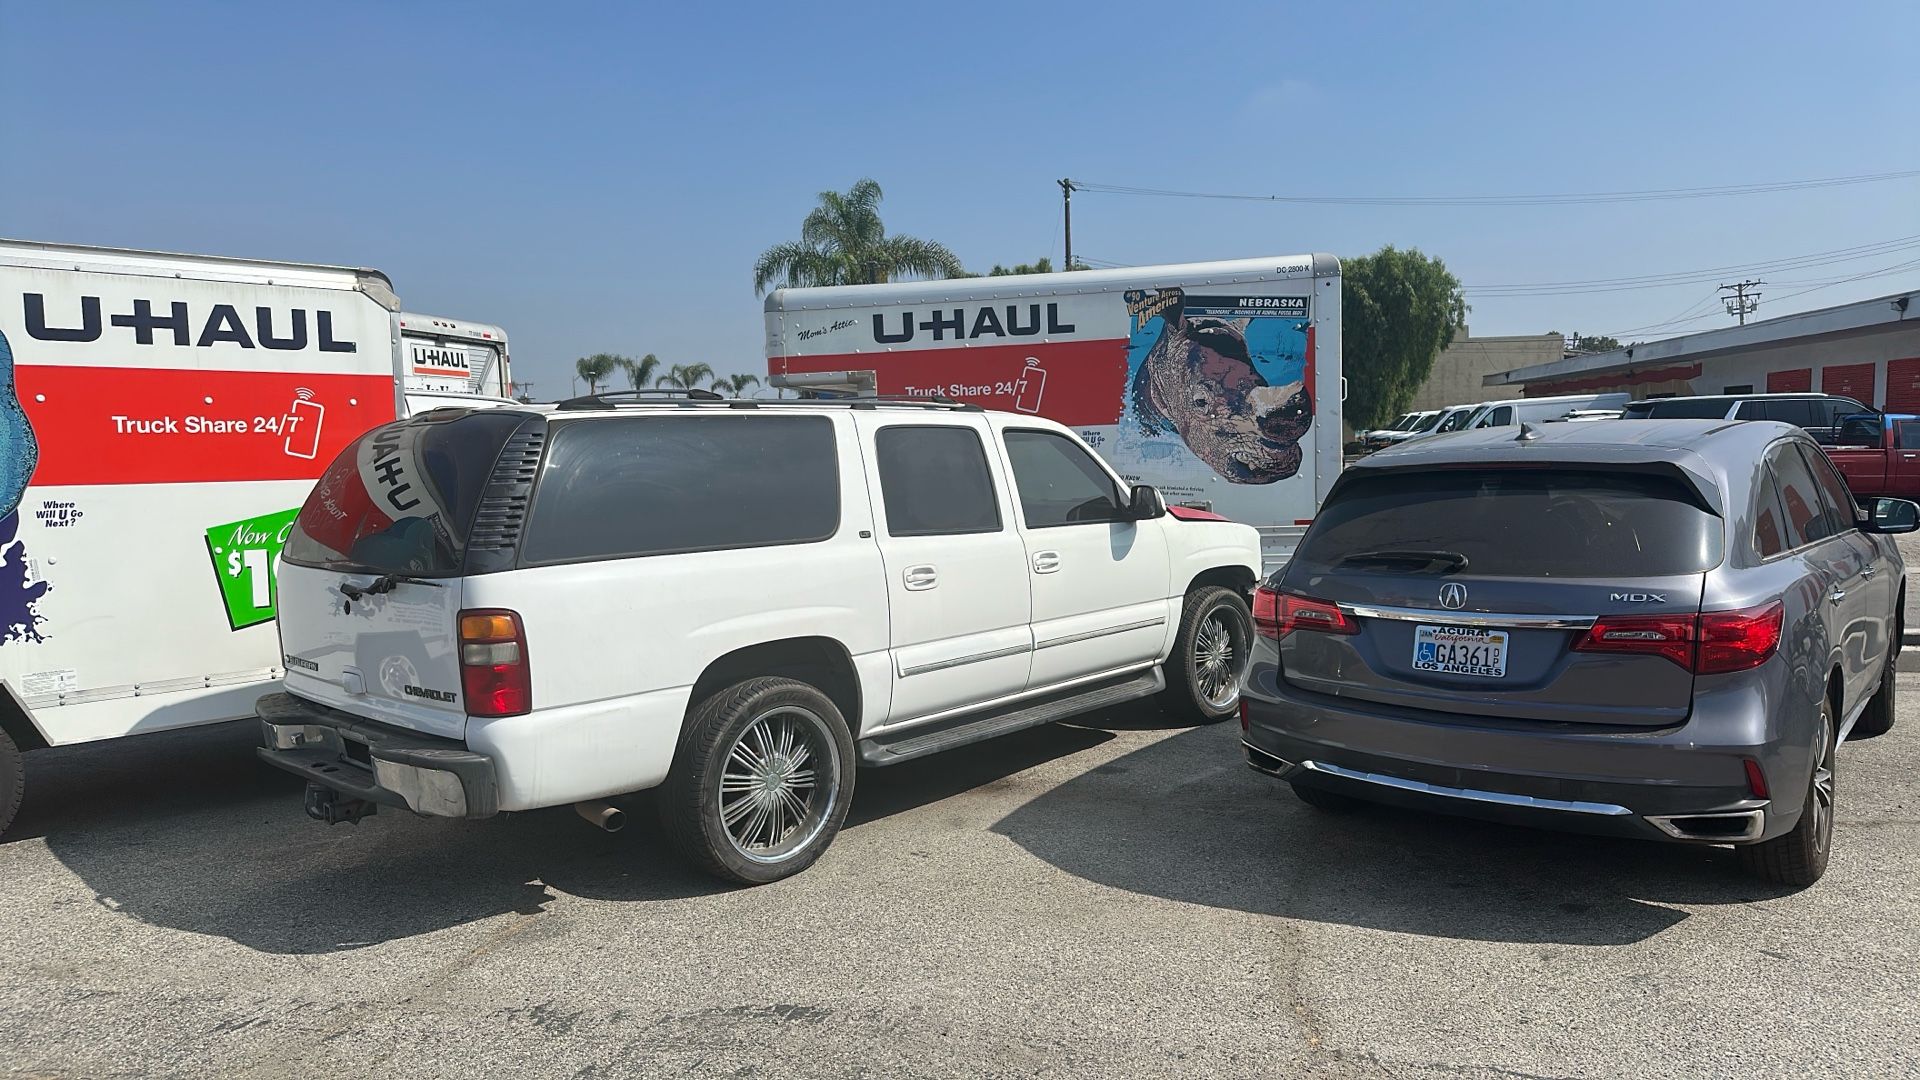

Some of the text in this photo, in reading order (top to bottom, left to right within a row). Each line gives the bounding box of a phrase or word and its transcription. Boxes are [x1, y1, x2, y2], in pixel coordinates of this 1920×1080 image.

[1161, 290, 1182, 299] Across
[1239, 298, 1304, 308] NEBRASKA
[23, 292, 357, 353] U-HAUL
[1138, 296, 1178, 332] America
[798, 319, 855, 341] Mom's Attic
[873, 303, 1076, 345] U-HAUL
[413, 347, 469, 369] U-HAUL
[905, 379, 1028, 397] Truck Share 24/7
[112, 416, 179, 434] Truck
[185, 416, 248, 434] Share
[43, 500, 75, 509] Where
[36, 509, 84, 520] Will U Go
[45, 517, 76, 528] Next?
[227, 523, 272, 546] Now
[1610, 593, 1667, 603] MDX
[1434, 633, 1484, 644] California
[1437, 627, 1485, 637] ACURA
[1435, 643, 1492, 667] GA361
[1414, 661, 1503, 677] LOS ANGELES
[404, 684, 457, 703] CHEVROLET
